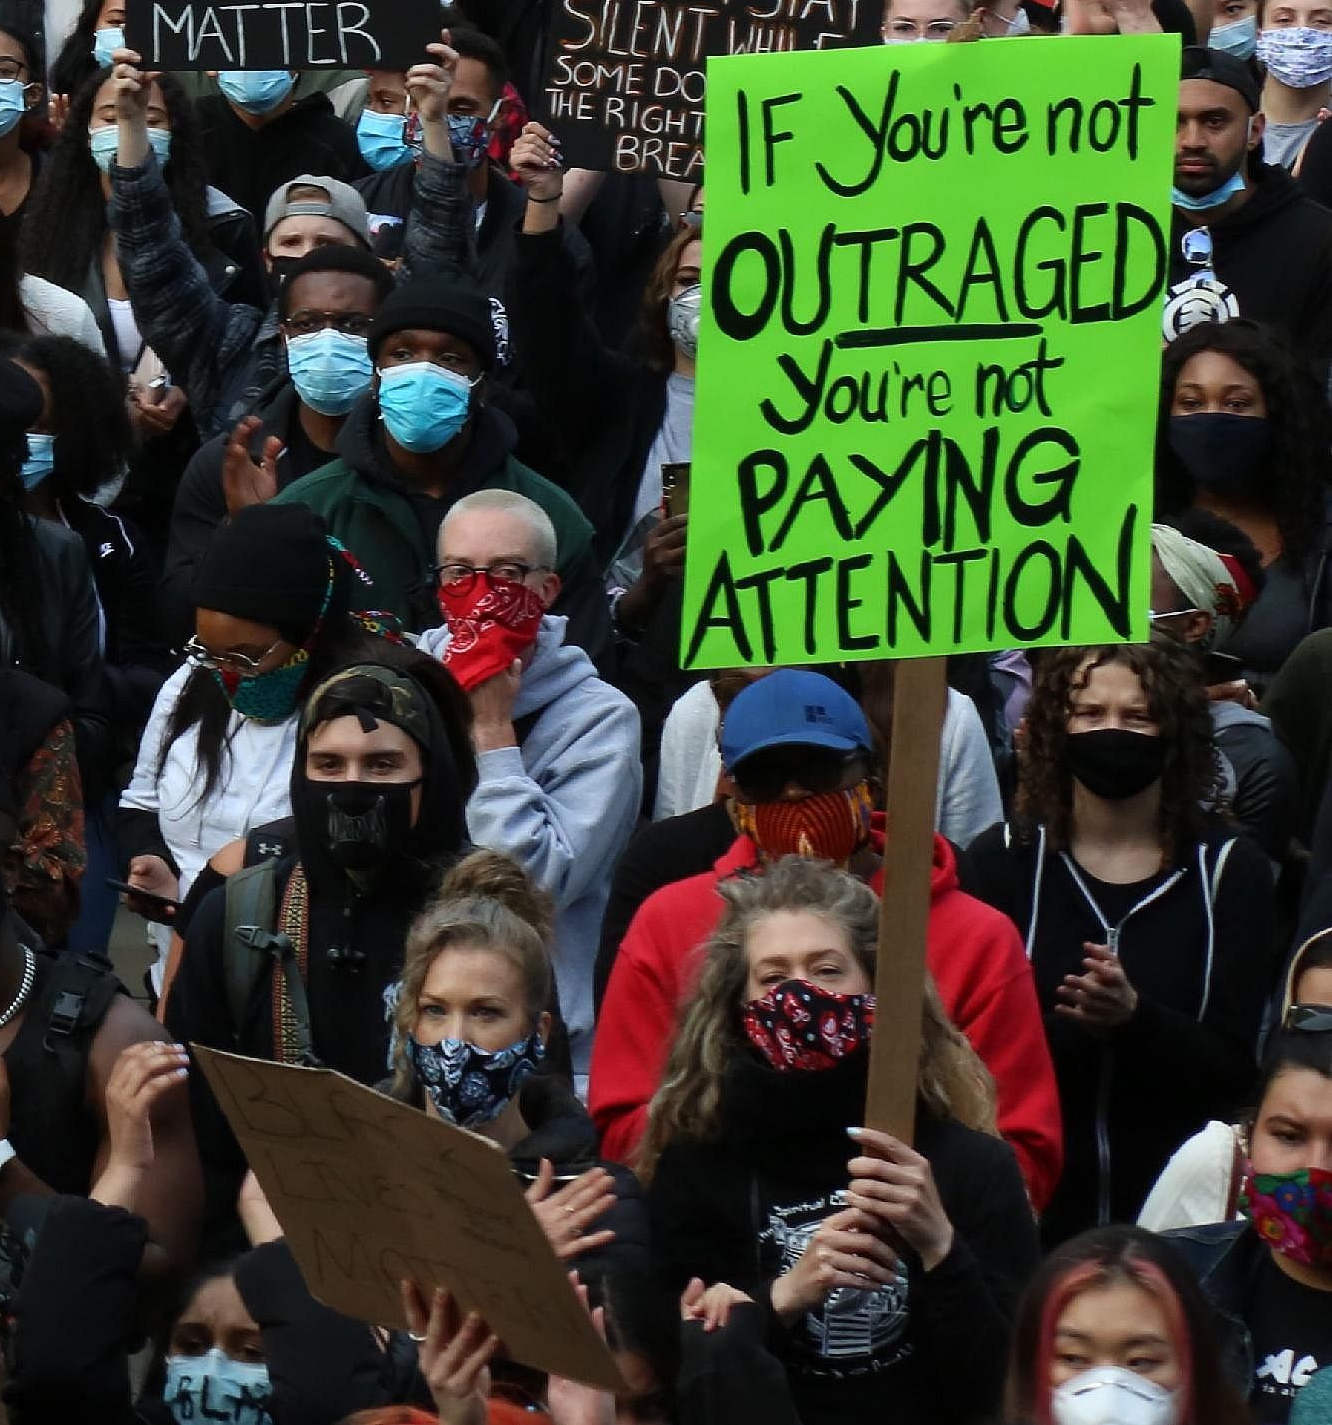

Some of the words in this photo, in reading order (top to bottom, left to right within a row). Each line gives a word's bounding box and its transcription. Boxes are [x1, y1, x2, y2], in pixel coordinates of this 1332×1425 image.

[151, 1, 381, 65] MATTER
[554, 57, 642, 101] SOME
[544, 87, 594, 121] THE
[737, 88, 803, 196] IF
[815, 69, 1029, 197] You're
[1047, 63, 1156, 162] not
[710, 201, 1166, 340] OUTRAGED
[759, 338, 952, 435] You're
[975, 337, 1065, 418] not
[737, 427, 1083, 558] PAYING
[682, 502, 1139, 670] ATTENTION
